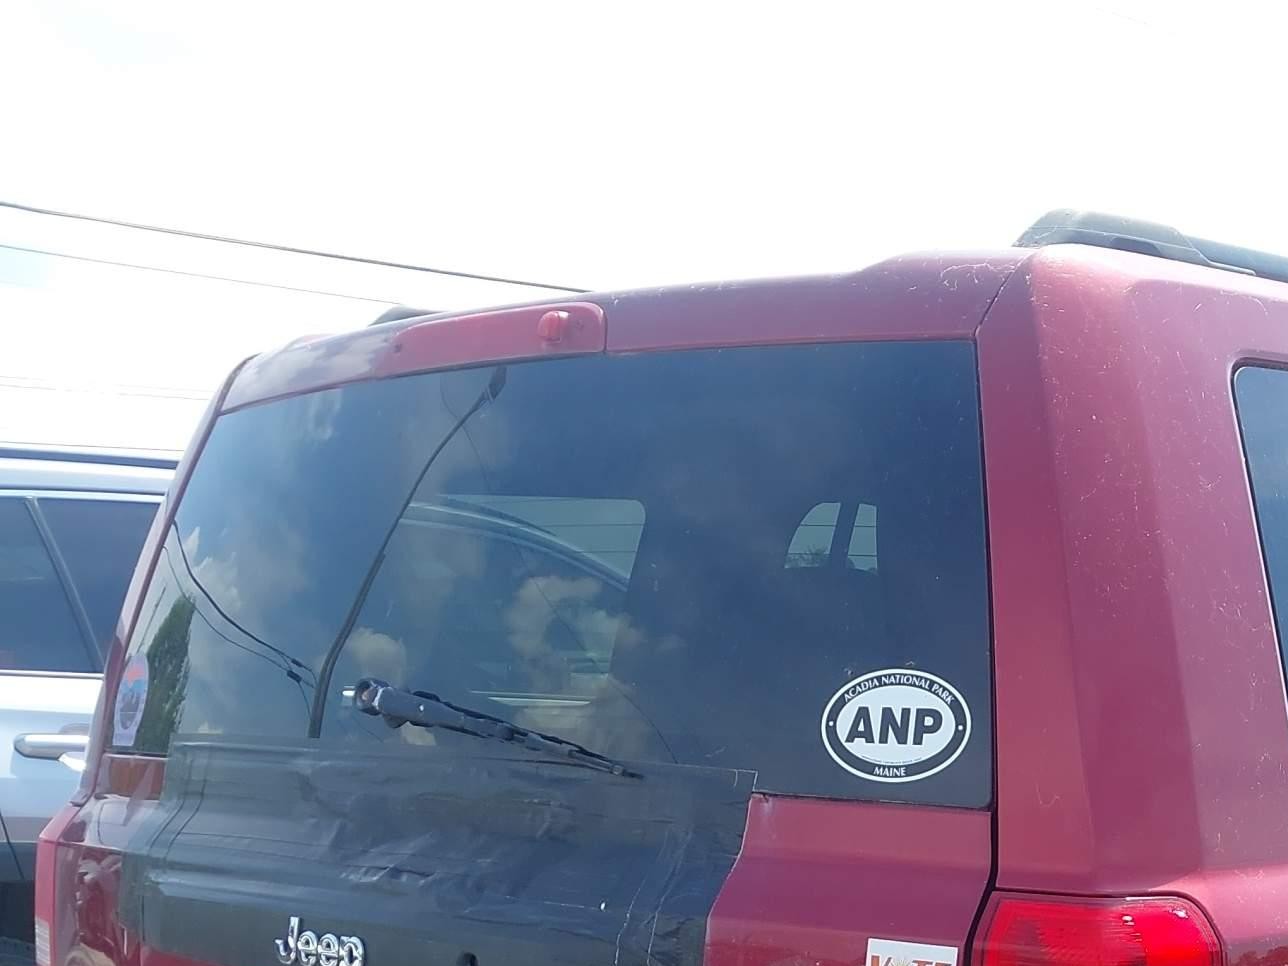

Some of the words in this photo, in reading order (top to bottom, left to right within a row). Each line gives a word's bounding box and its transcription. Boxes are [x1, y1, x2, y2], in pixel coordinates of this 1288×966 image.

[844, 678, 879, 703] ACADIA
[881, 674, 931, 690] NATIONAL
[931, 683, 955, 705] PARK
[844, 706, 943, 746] ANP
[873, 766, 907, 777] MAINE
